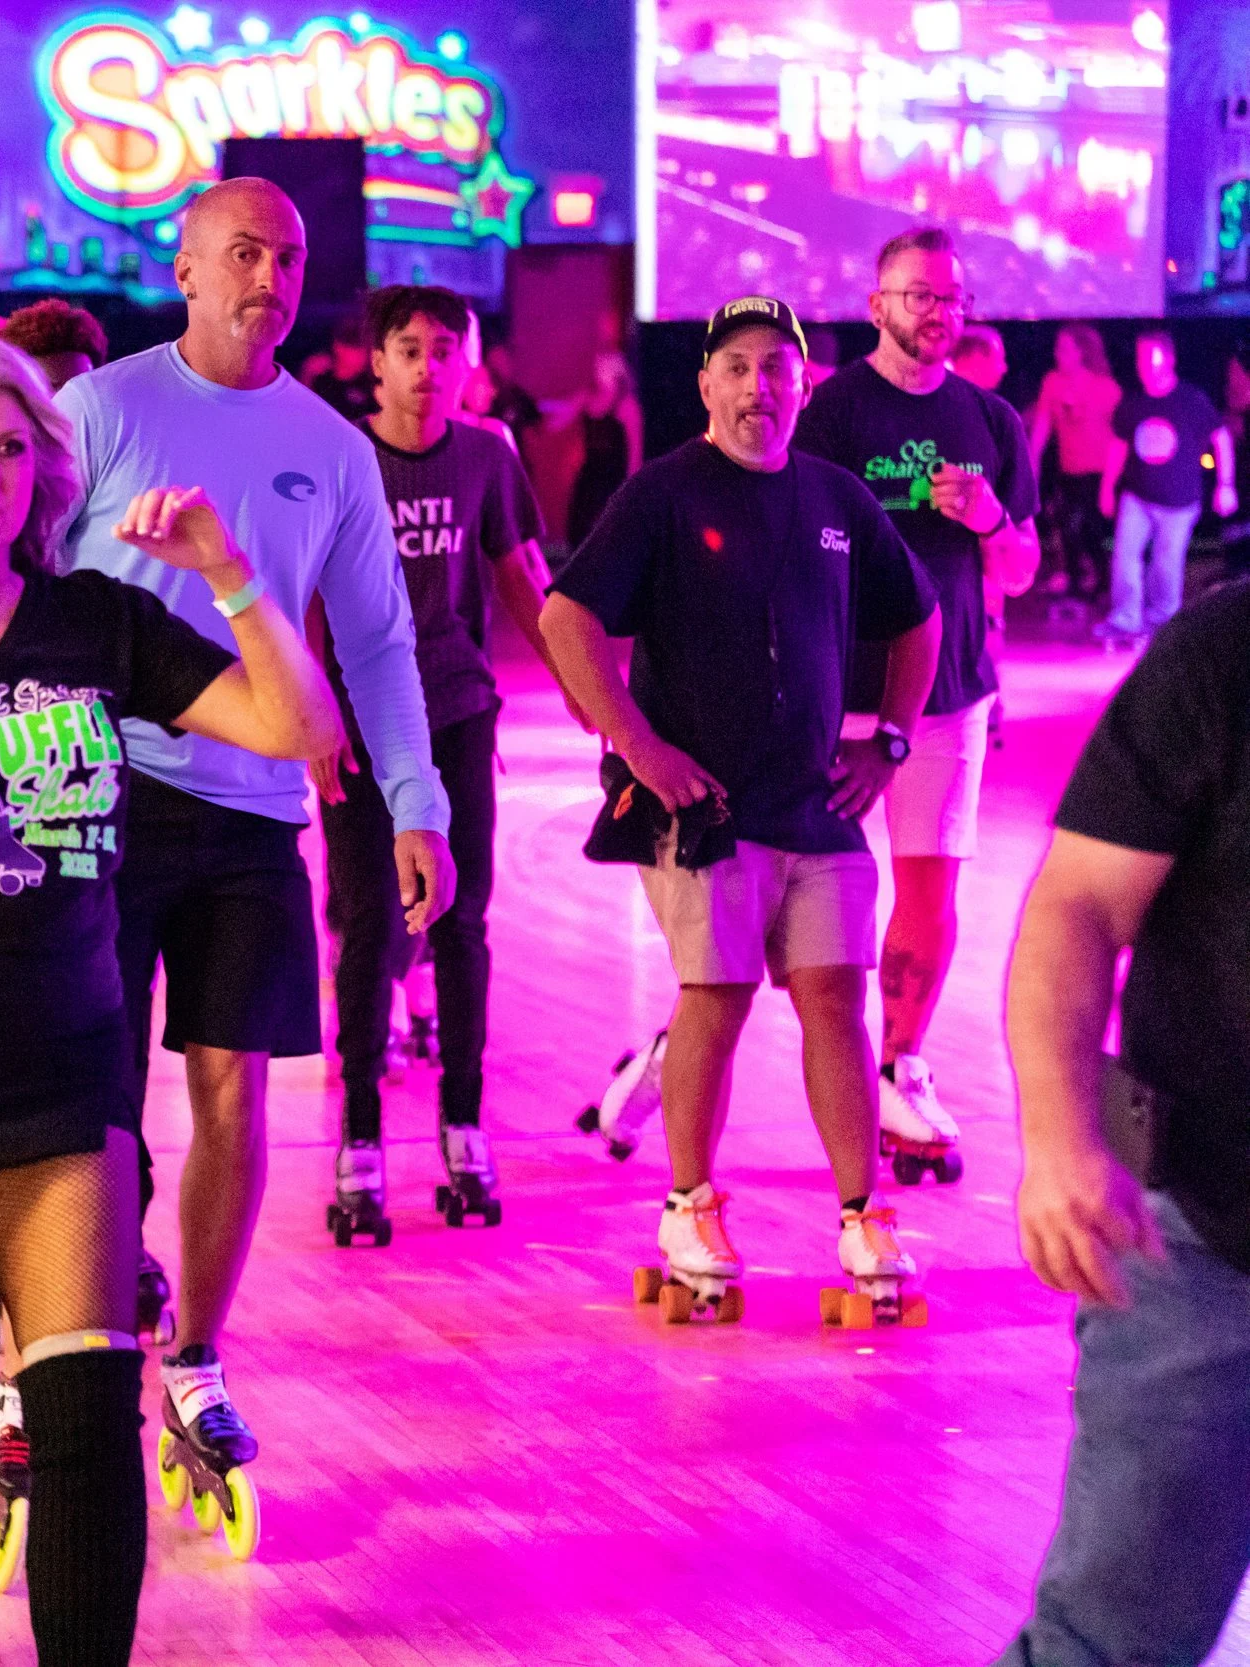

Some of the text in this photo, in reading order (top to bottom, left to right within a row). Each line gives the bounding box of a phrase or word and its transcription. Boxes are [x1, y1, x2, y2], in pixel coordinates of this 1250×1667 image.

[57, 30, 488, 196] Sparkles
[900, 439, 937, 463] OG
[820, 527, 851, 555] Ford
[5, 762, 119, 829] Skate
